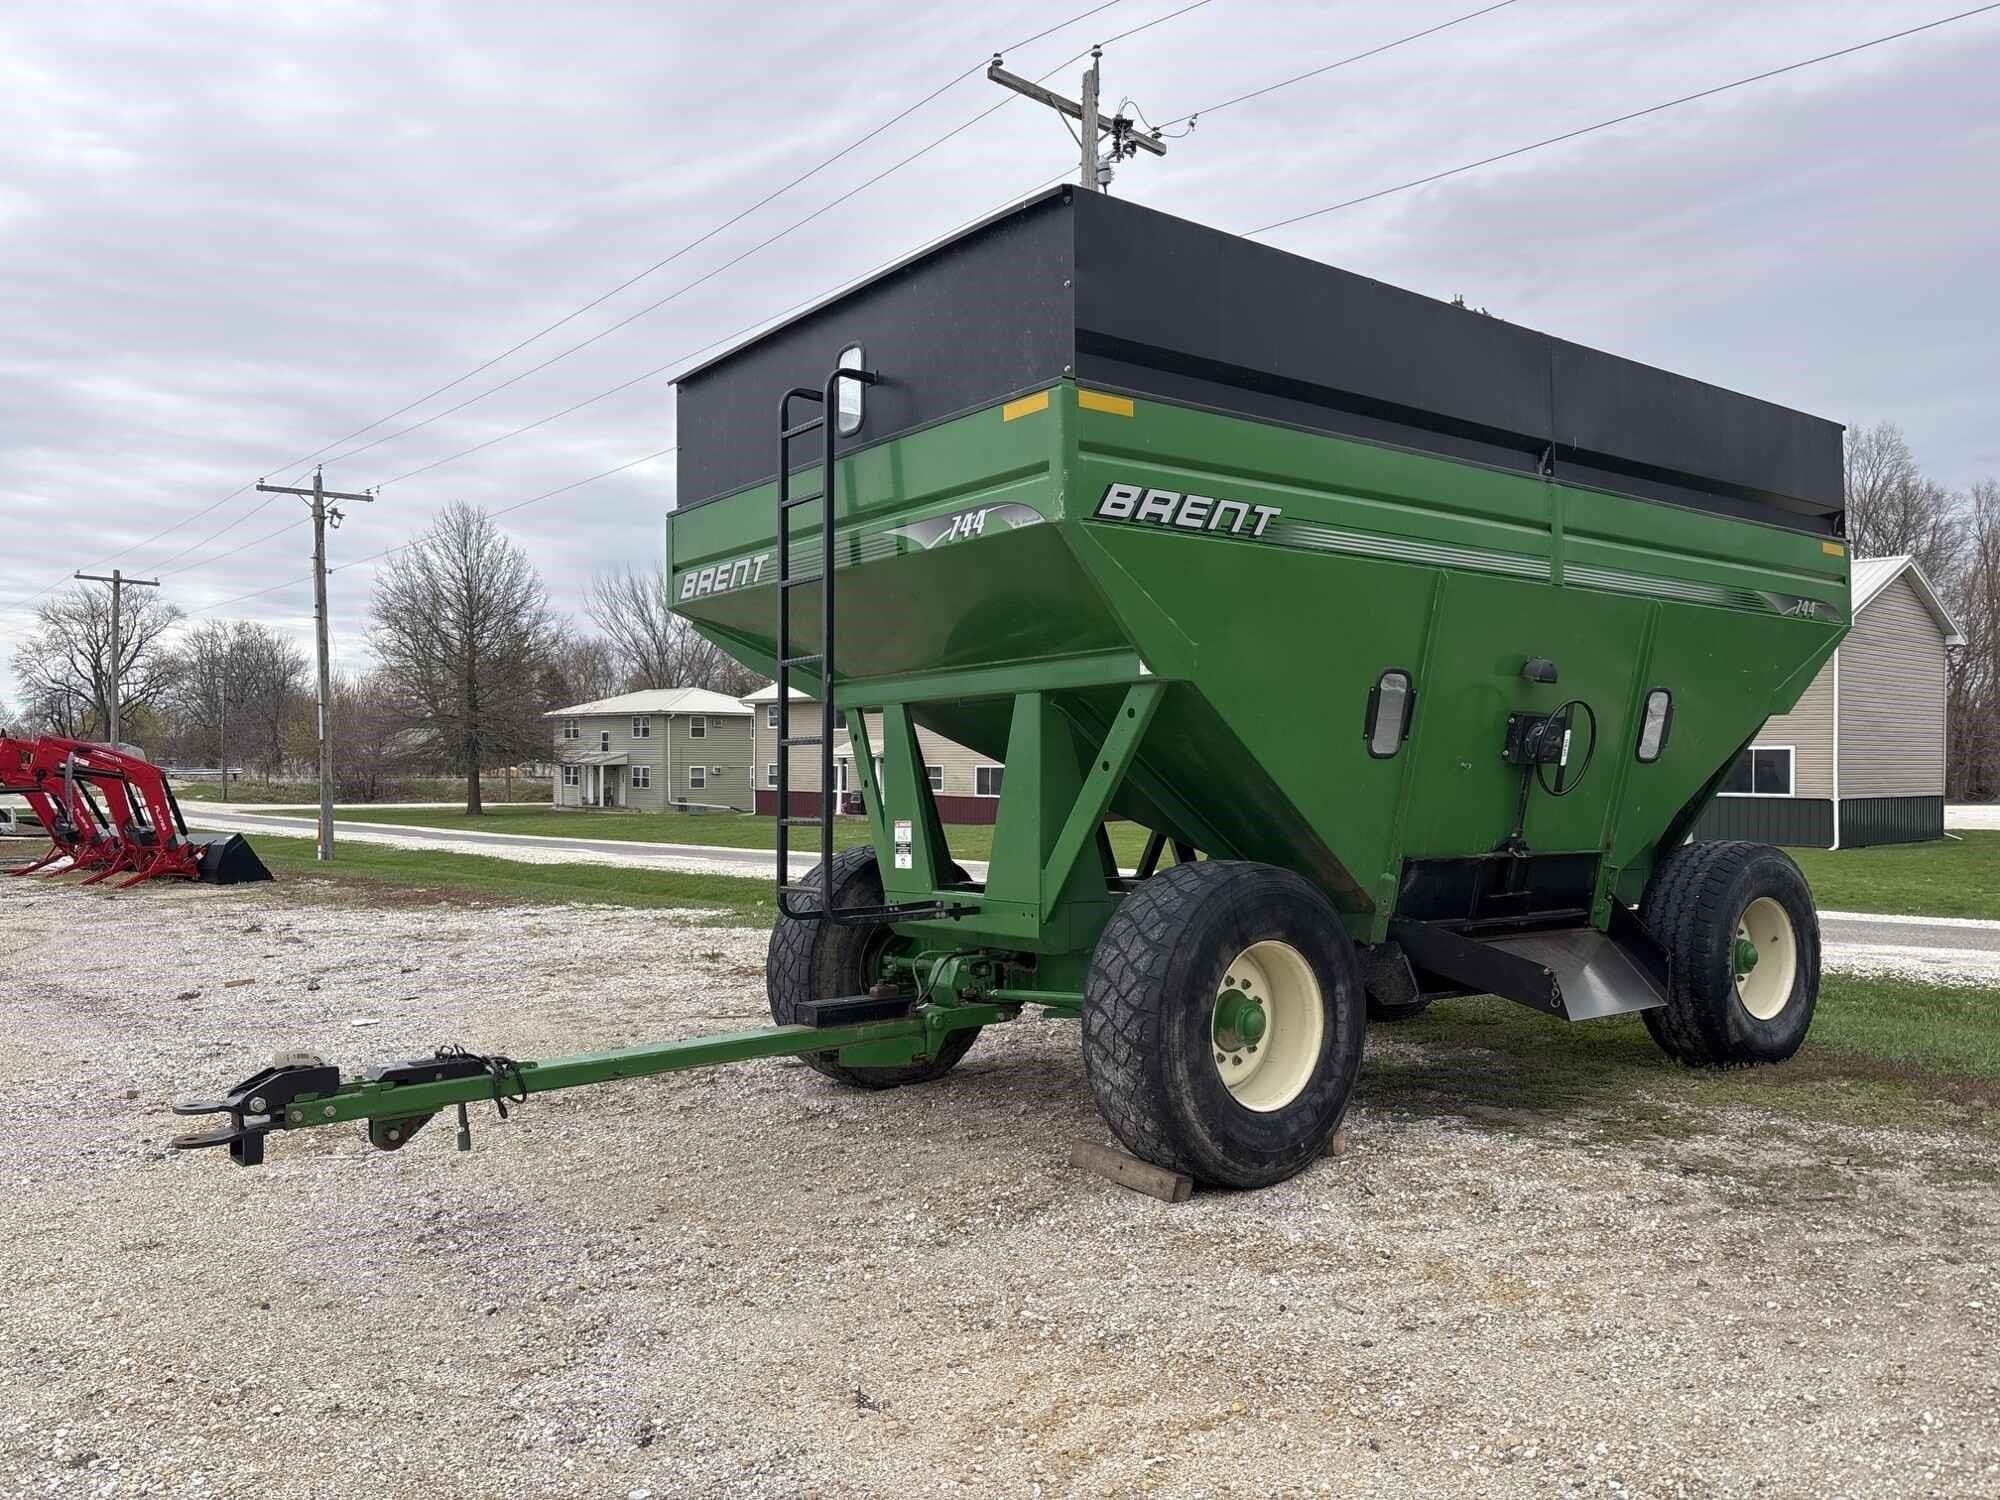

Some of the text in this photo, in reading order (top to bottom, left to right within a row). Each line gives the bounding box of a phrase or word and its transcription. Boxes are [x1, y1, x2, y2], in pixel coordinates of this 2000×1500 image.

[949, 509, 986, 541] 744
[1097, 482, 1283, 537] BRENT
[680, 554, 770, 599] BRENT
[1794, 599, 1816, 617] 744
